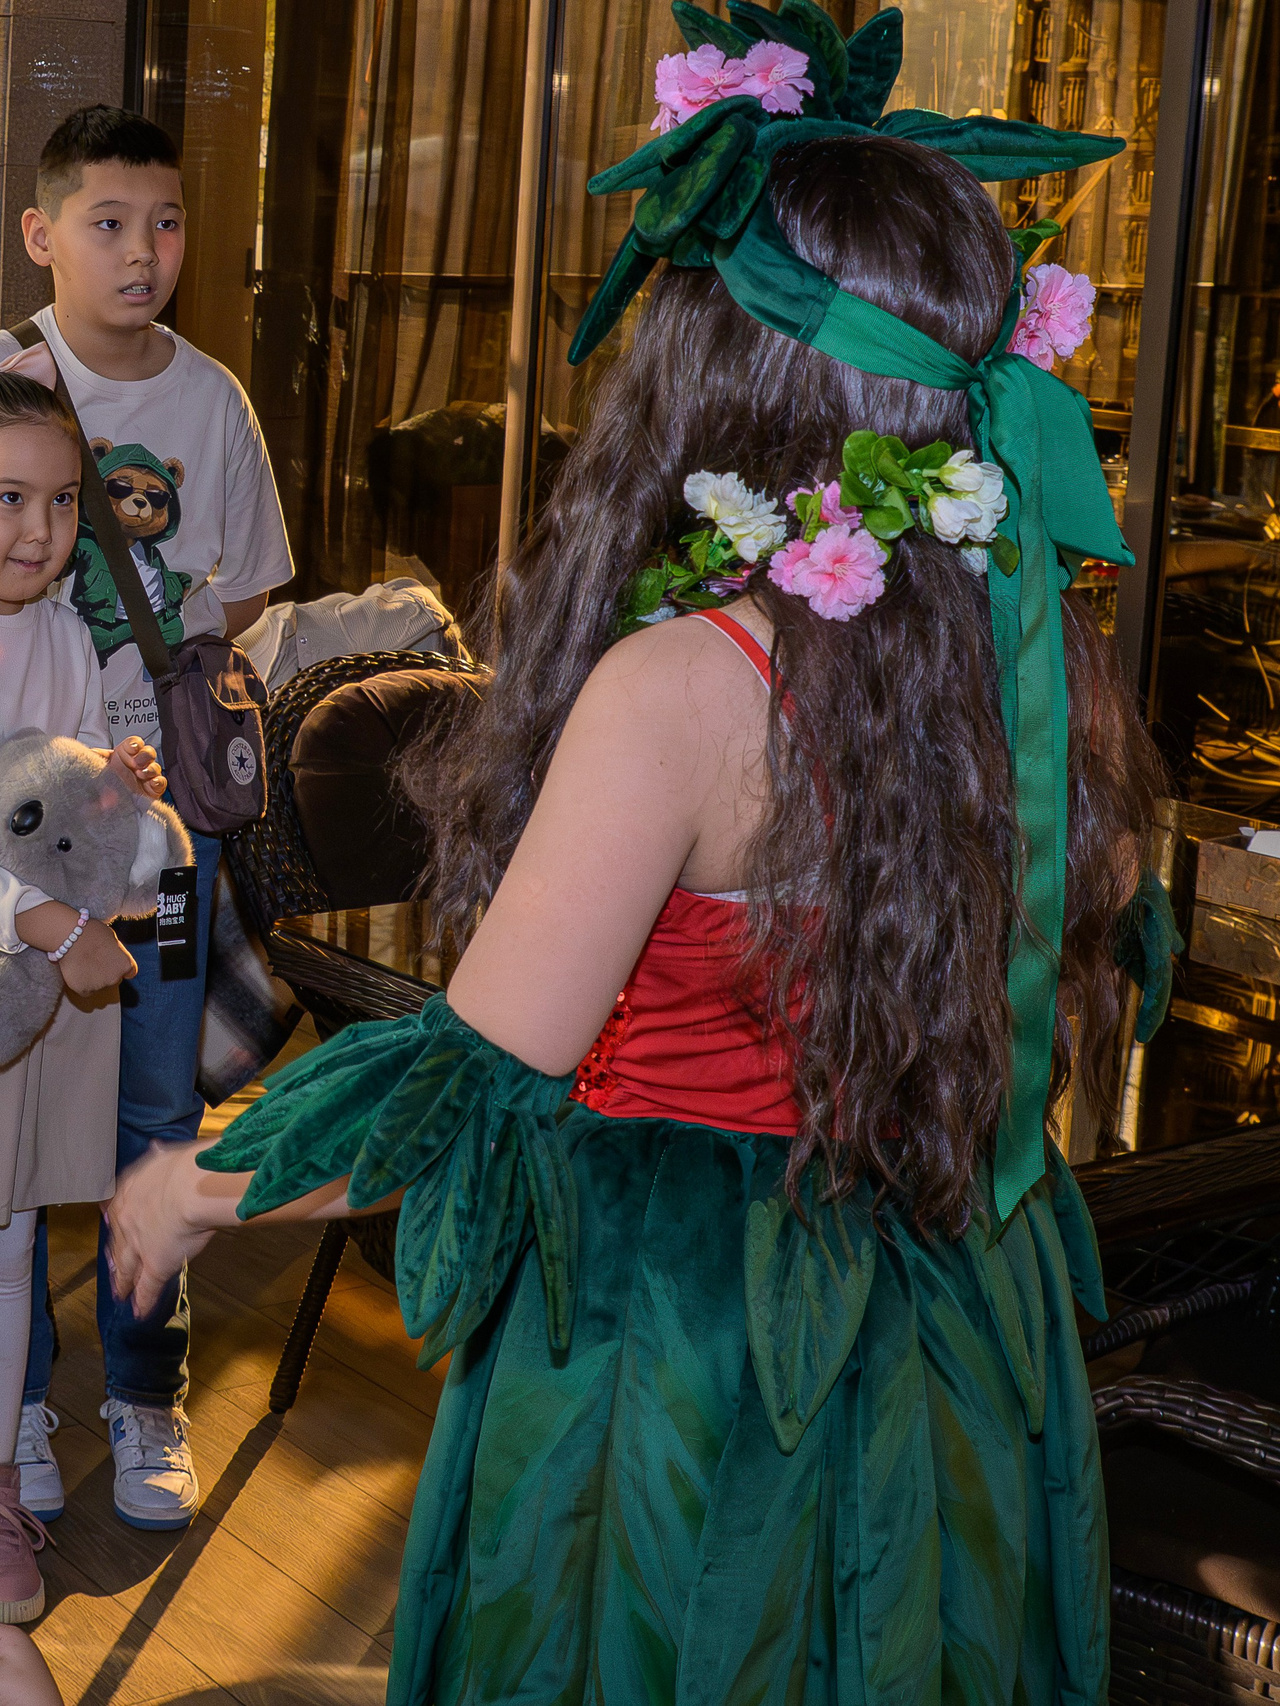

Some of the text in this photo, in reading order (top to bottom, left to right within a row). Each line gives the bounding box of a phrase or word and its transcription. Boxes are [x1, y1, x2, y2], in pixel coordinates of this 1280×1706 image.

[105, 700, 119, 712] е,
[108, 714, 120, 725] е
[166, 893, 187, 904] HUGS
